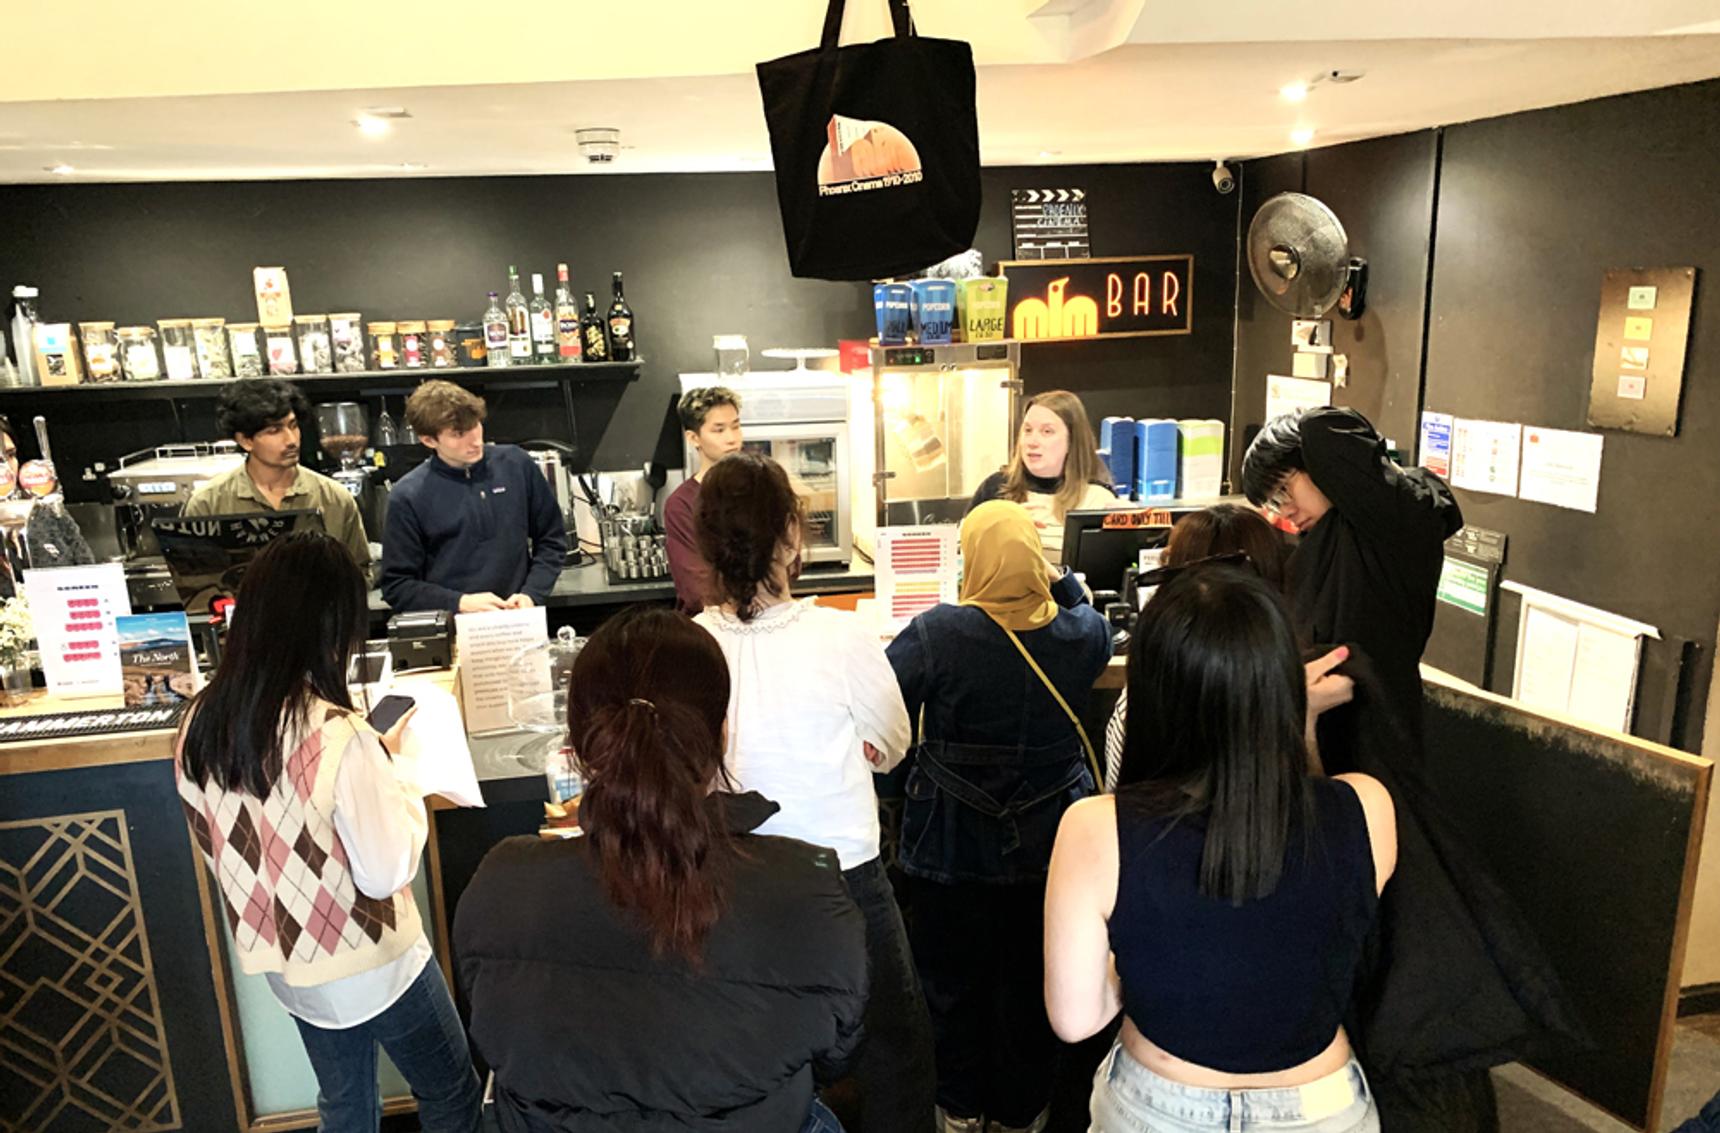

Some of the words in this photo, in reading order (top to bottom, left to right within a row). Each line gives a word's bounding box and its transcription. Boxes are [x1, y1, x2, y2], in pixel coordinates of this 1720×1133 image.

[1107, 271, 1179, 317] BAR
[920, 321, 953, 335] MEDIUM
[969, 317, 1003, 332] LARGE
[1103, 513, 1128, 526] CARD
[132, 651, 152, 664] The
[151, 650, 179, 663] North
